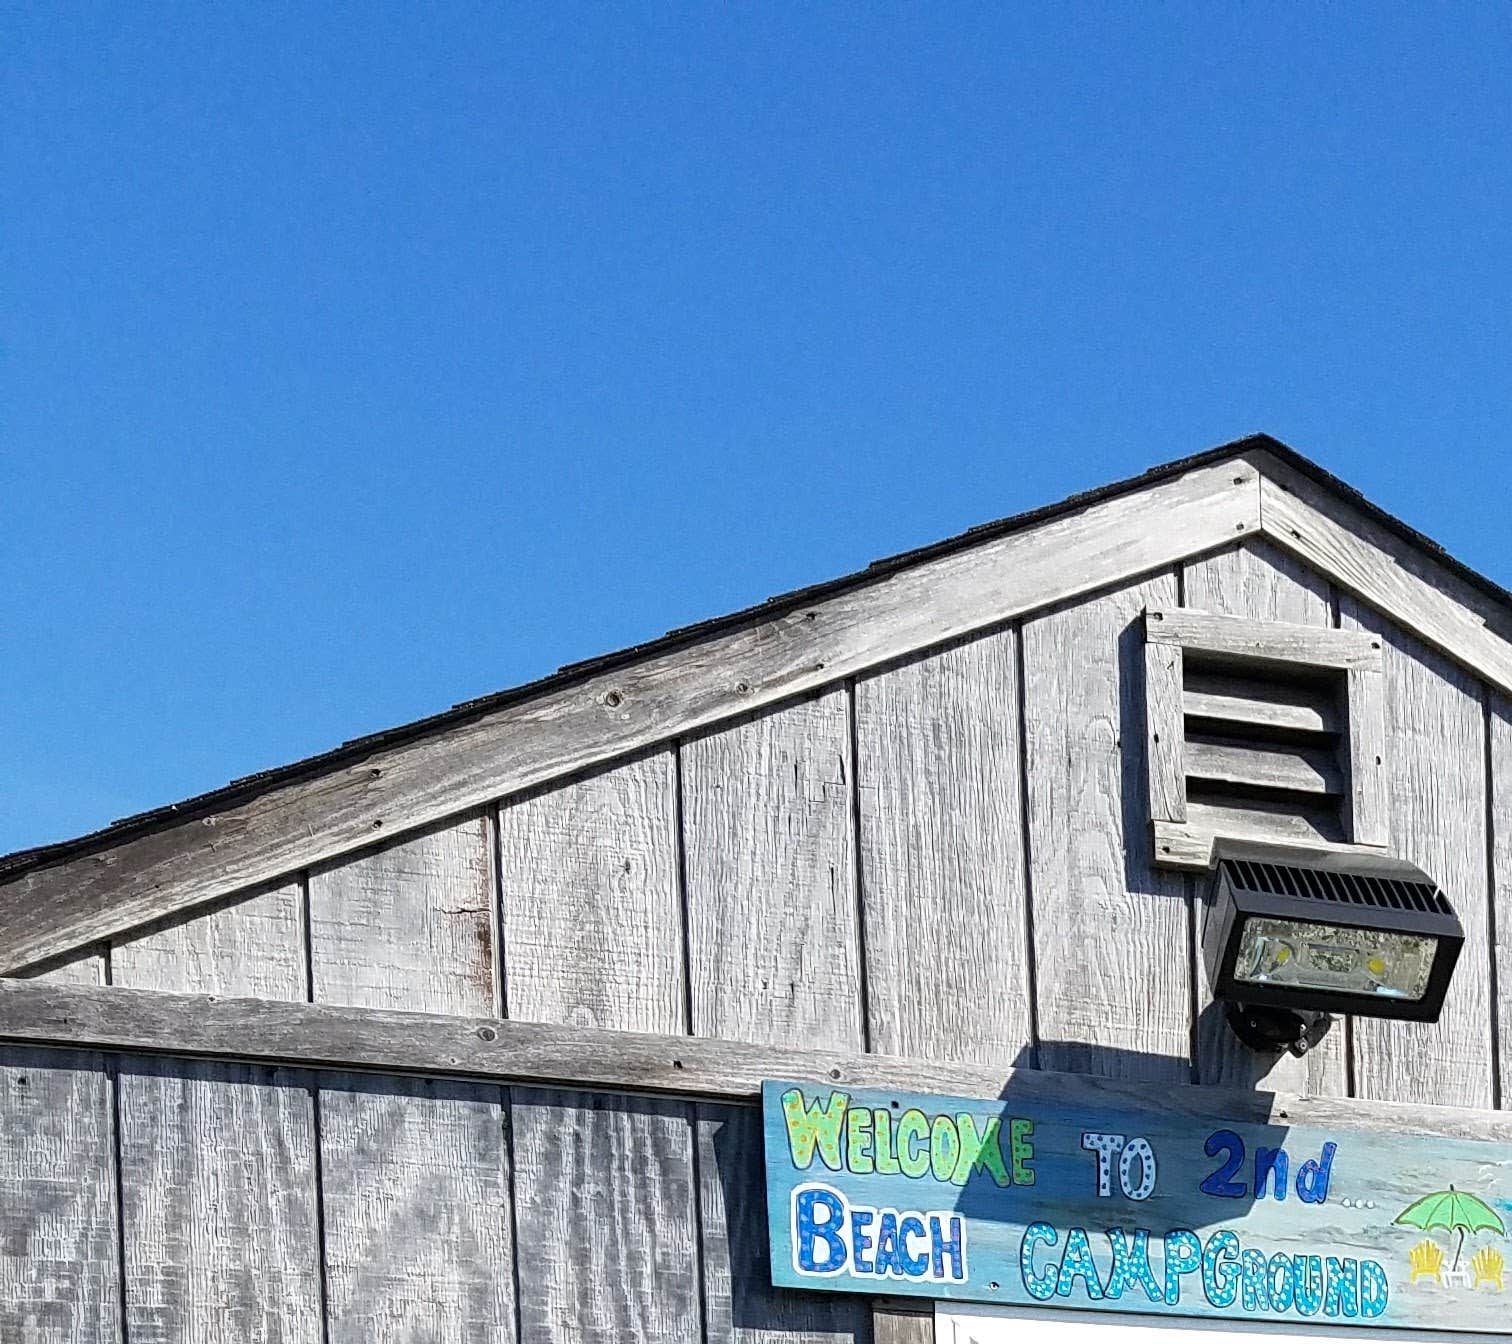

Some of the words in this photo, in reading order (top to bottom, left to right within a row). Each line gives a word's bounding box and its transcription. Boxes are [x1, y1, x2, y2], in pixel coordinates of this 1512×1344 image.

[781, 1088, 1036, 1188] WELCOME
[1081, 1131, 1157, 1201] TO
[794, 1186, 966, 1281] BEACH
[1019, 1220, 1389, 1318] CAMPGROUND
